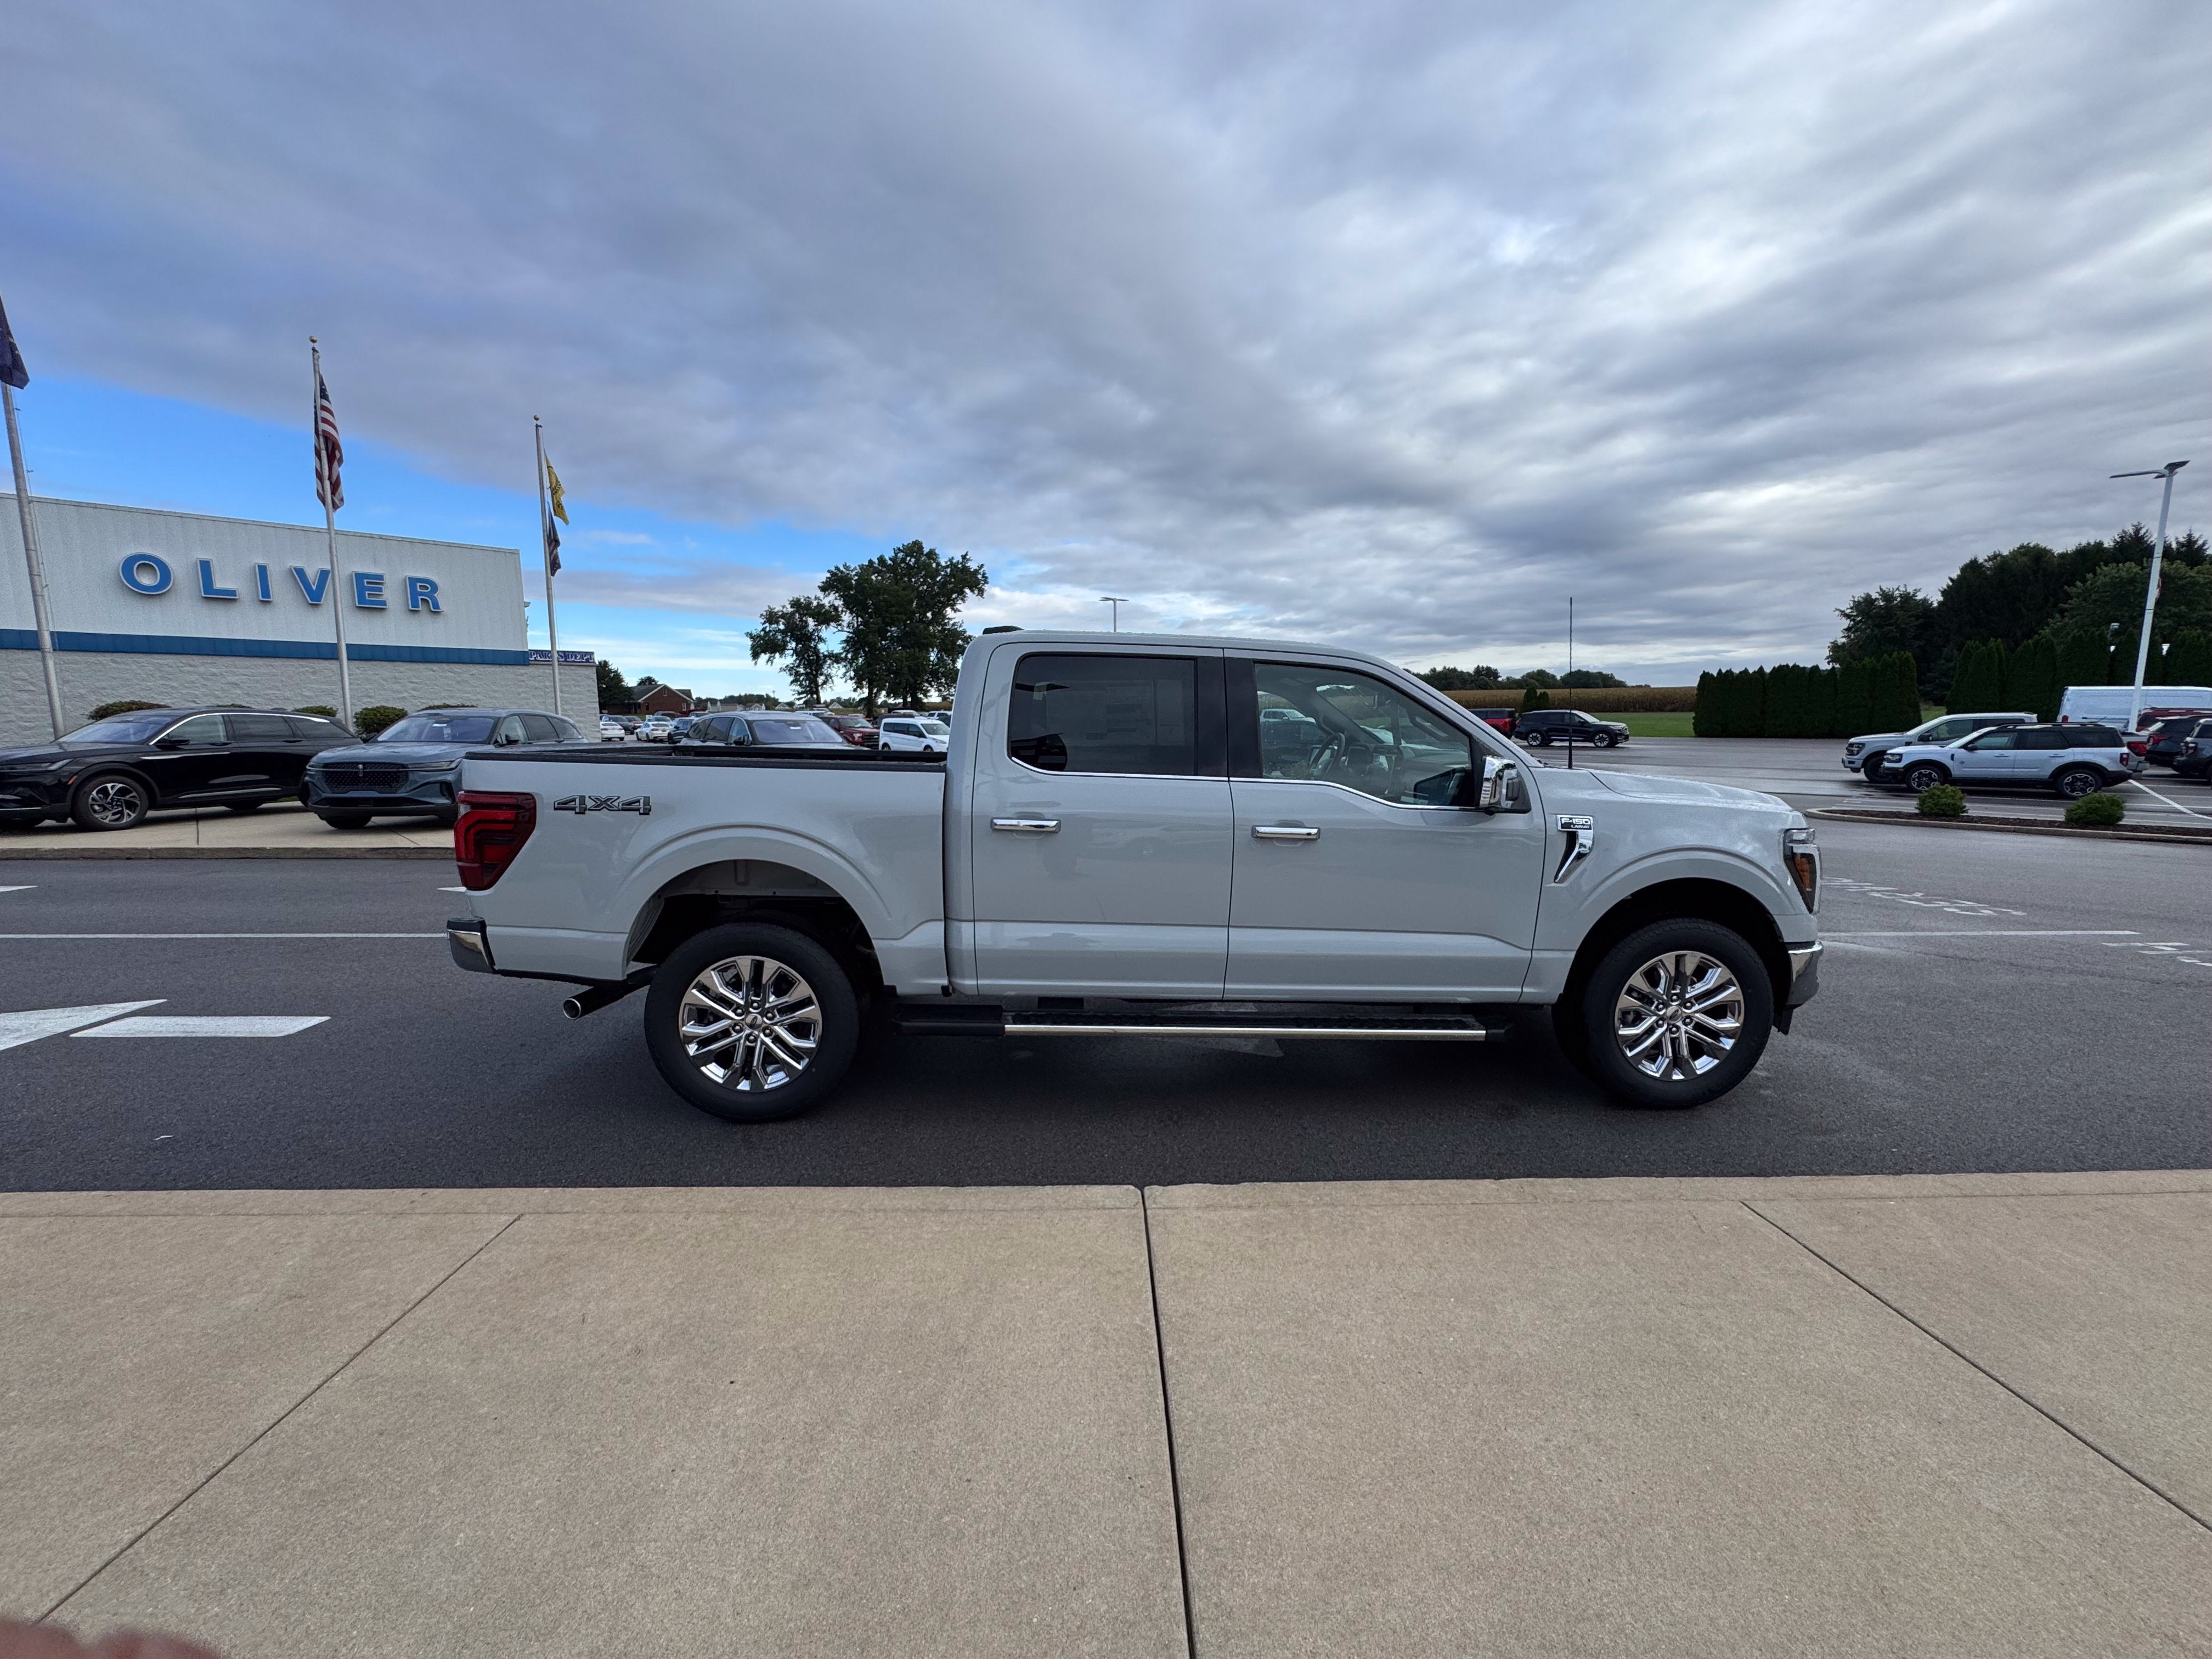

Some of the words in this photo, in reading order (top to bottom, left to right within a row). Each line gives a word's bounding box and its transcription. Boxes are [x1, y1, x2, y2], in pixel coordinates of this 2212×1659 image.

[119, 552, 442, 612] OLIVER
[529, 651, 565, 661] PARS
[566, 653, 593, 662] DEPT
